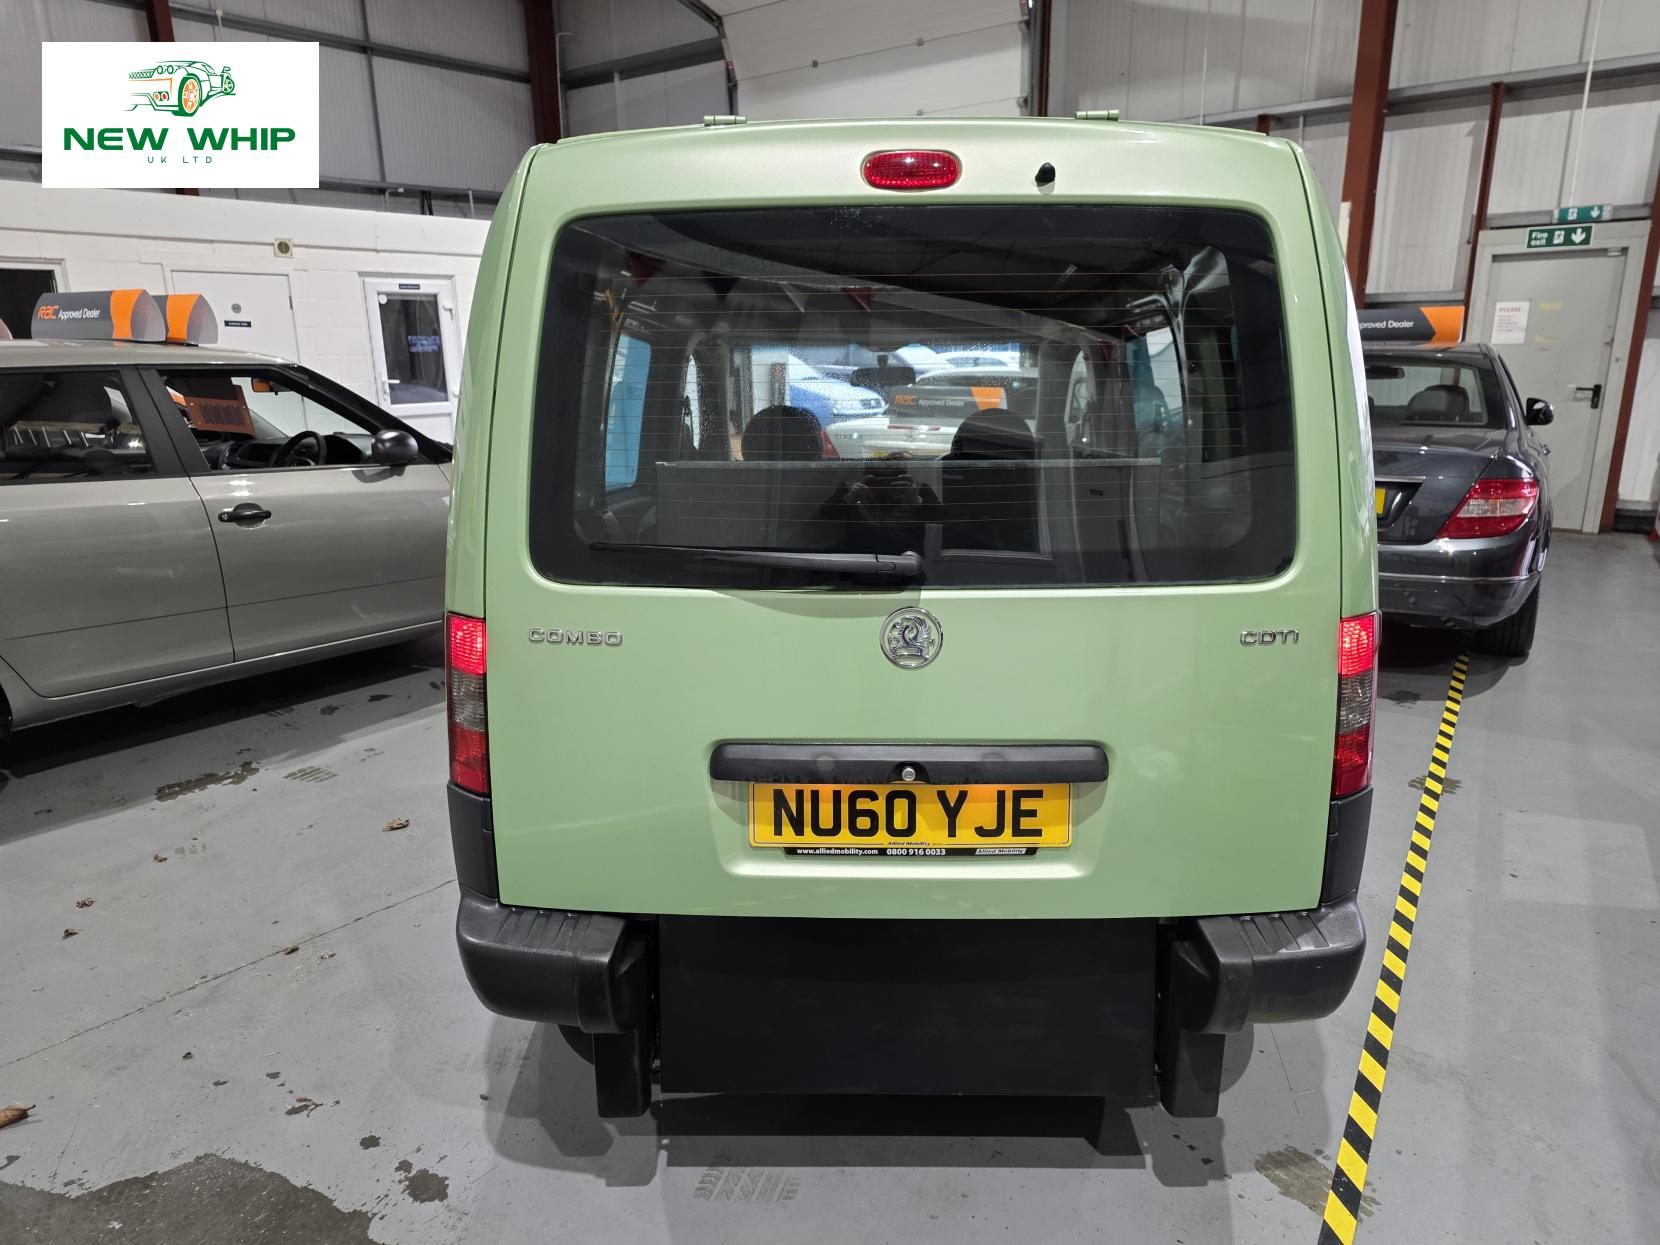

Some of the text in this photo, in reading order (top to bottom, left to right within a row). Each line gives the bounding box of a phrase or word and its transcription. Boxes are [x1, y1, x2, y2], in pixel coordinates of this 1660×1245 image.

[1531, 231, 1549, 239] Fire
[38, 305, 101, 320] RAC Approved Dealer
[1387, 320, 1414, 328] Dealer
[528, 628, 623, 646] COMBO
[772, 788, 1044, 838] NU60 YJE
[796, 847, 946, 856] www.alliedmobility.com 0800 916 0033
